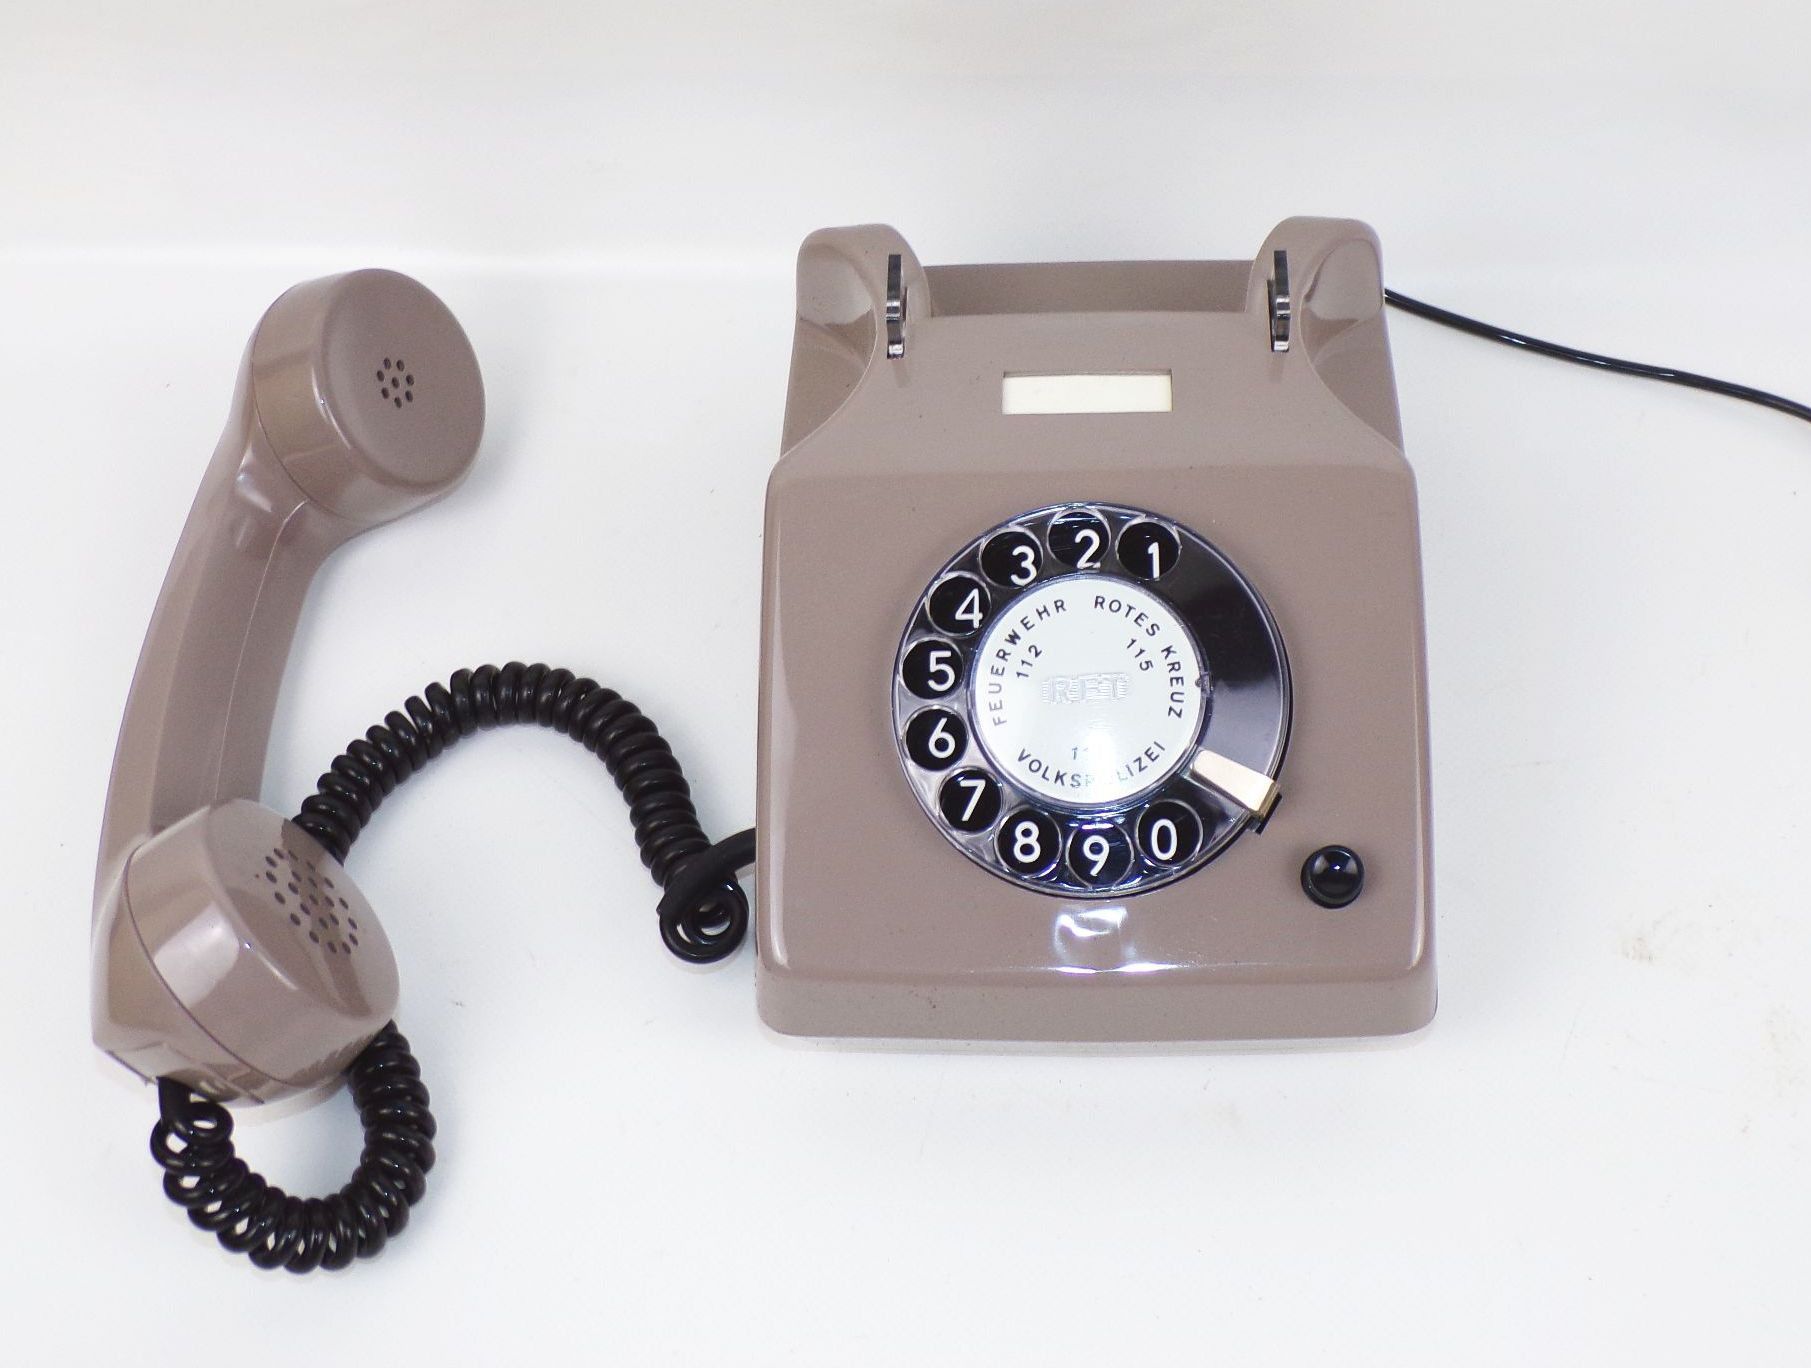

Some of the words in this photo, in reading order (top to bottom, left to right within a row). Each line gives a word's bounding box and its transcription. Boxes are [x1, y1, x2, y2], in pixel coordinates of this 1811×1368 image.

[1010, 545, 1037, 585] 3
[1074, 529, 1101, 568] 2
[1147, 543, 1160, 579] 1
[954, 590, 983, 628] 4
[927, 651, 955, 691] 5
[988, 598, 1067, 727] FEUERWEHR
[1016, 643, 1043, 680] 112
[1094, 594, 1161, 637] ROTES
[1161, 645, 1185, 719] KREUZ
[1125, 637, 1154, 673] 115
[928, 718, 956, 758] 6
[960, 779, 986, 822] 7
[1014, 821, 1042, 863] 8
[1084, 835, 1110, 876] 9
[1153, 820, 1177, 861] 0
